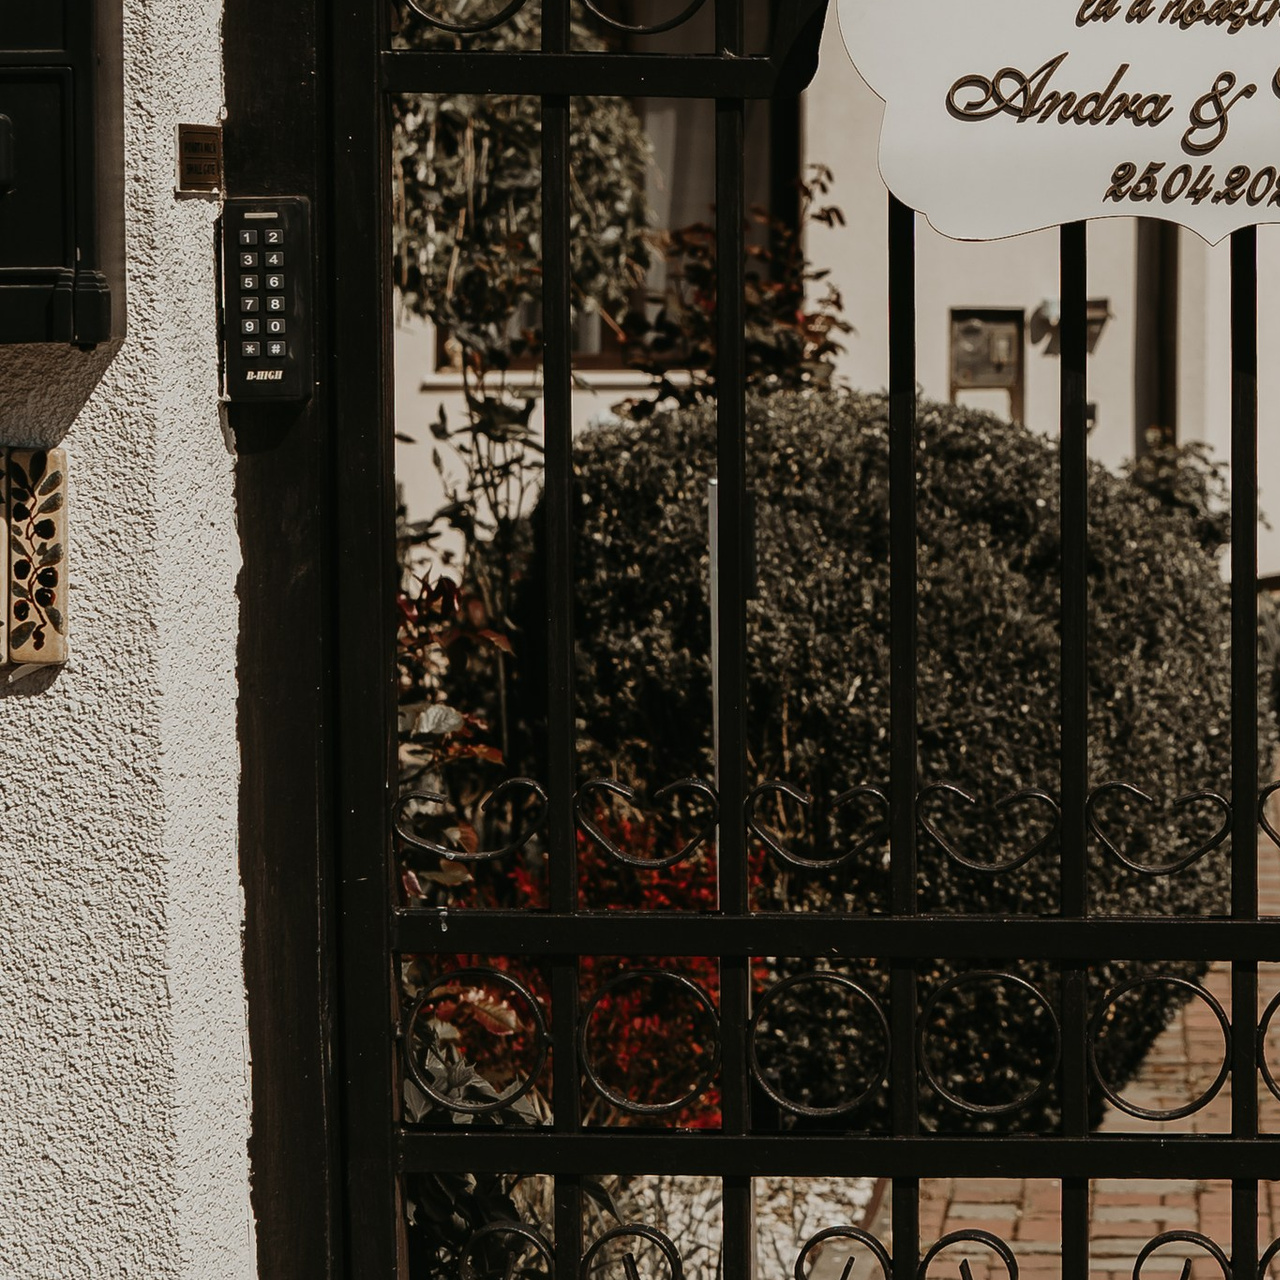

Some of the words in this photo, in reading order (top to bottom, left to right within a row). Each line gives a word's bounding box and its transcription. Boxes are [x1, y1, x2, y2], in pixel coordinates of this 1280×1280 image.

[946, 51, 1174, 128] Andra
[1180, 71, 1258, 156] &
[243, 232, 250, 243] 1
[268, 232, 278, 243] 2
[243, 254, 253, 265] 3
[268, 254, 279, 265] 4
[244, 277, 253, 288] 5
[269, 276, 279, 287] 6
[245, 299, 254, 310] 7
[270, 299, 280, 310] 8
[245, 321, 254, 332] 9
[271, 321, 280, 332] 0
[246, 370, 283, 381] B-HIGH
